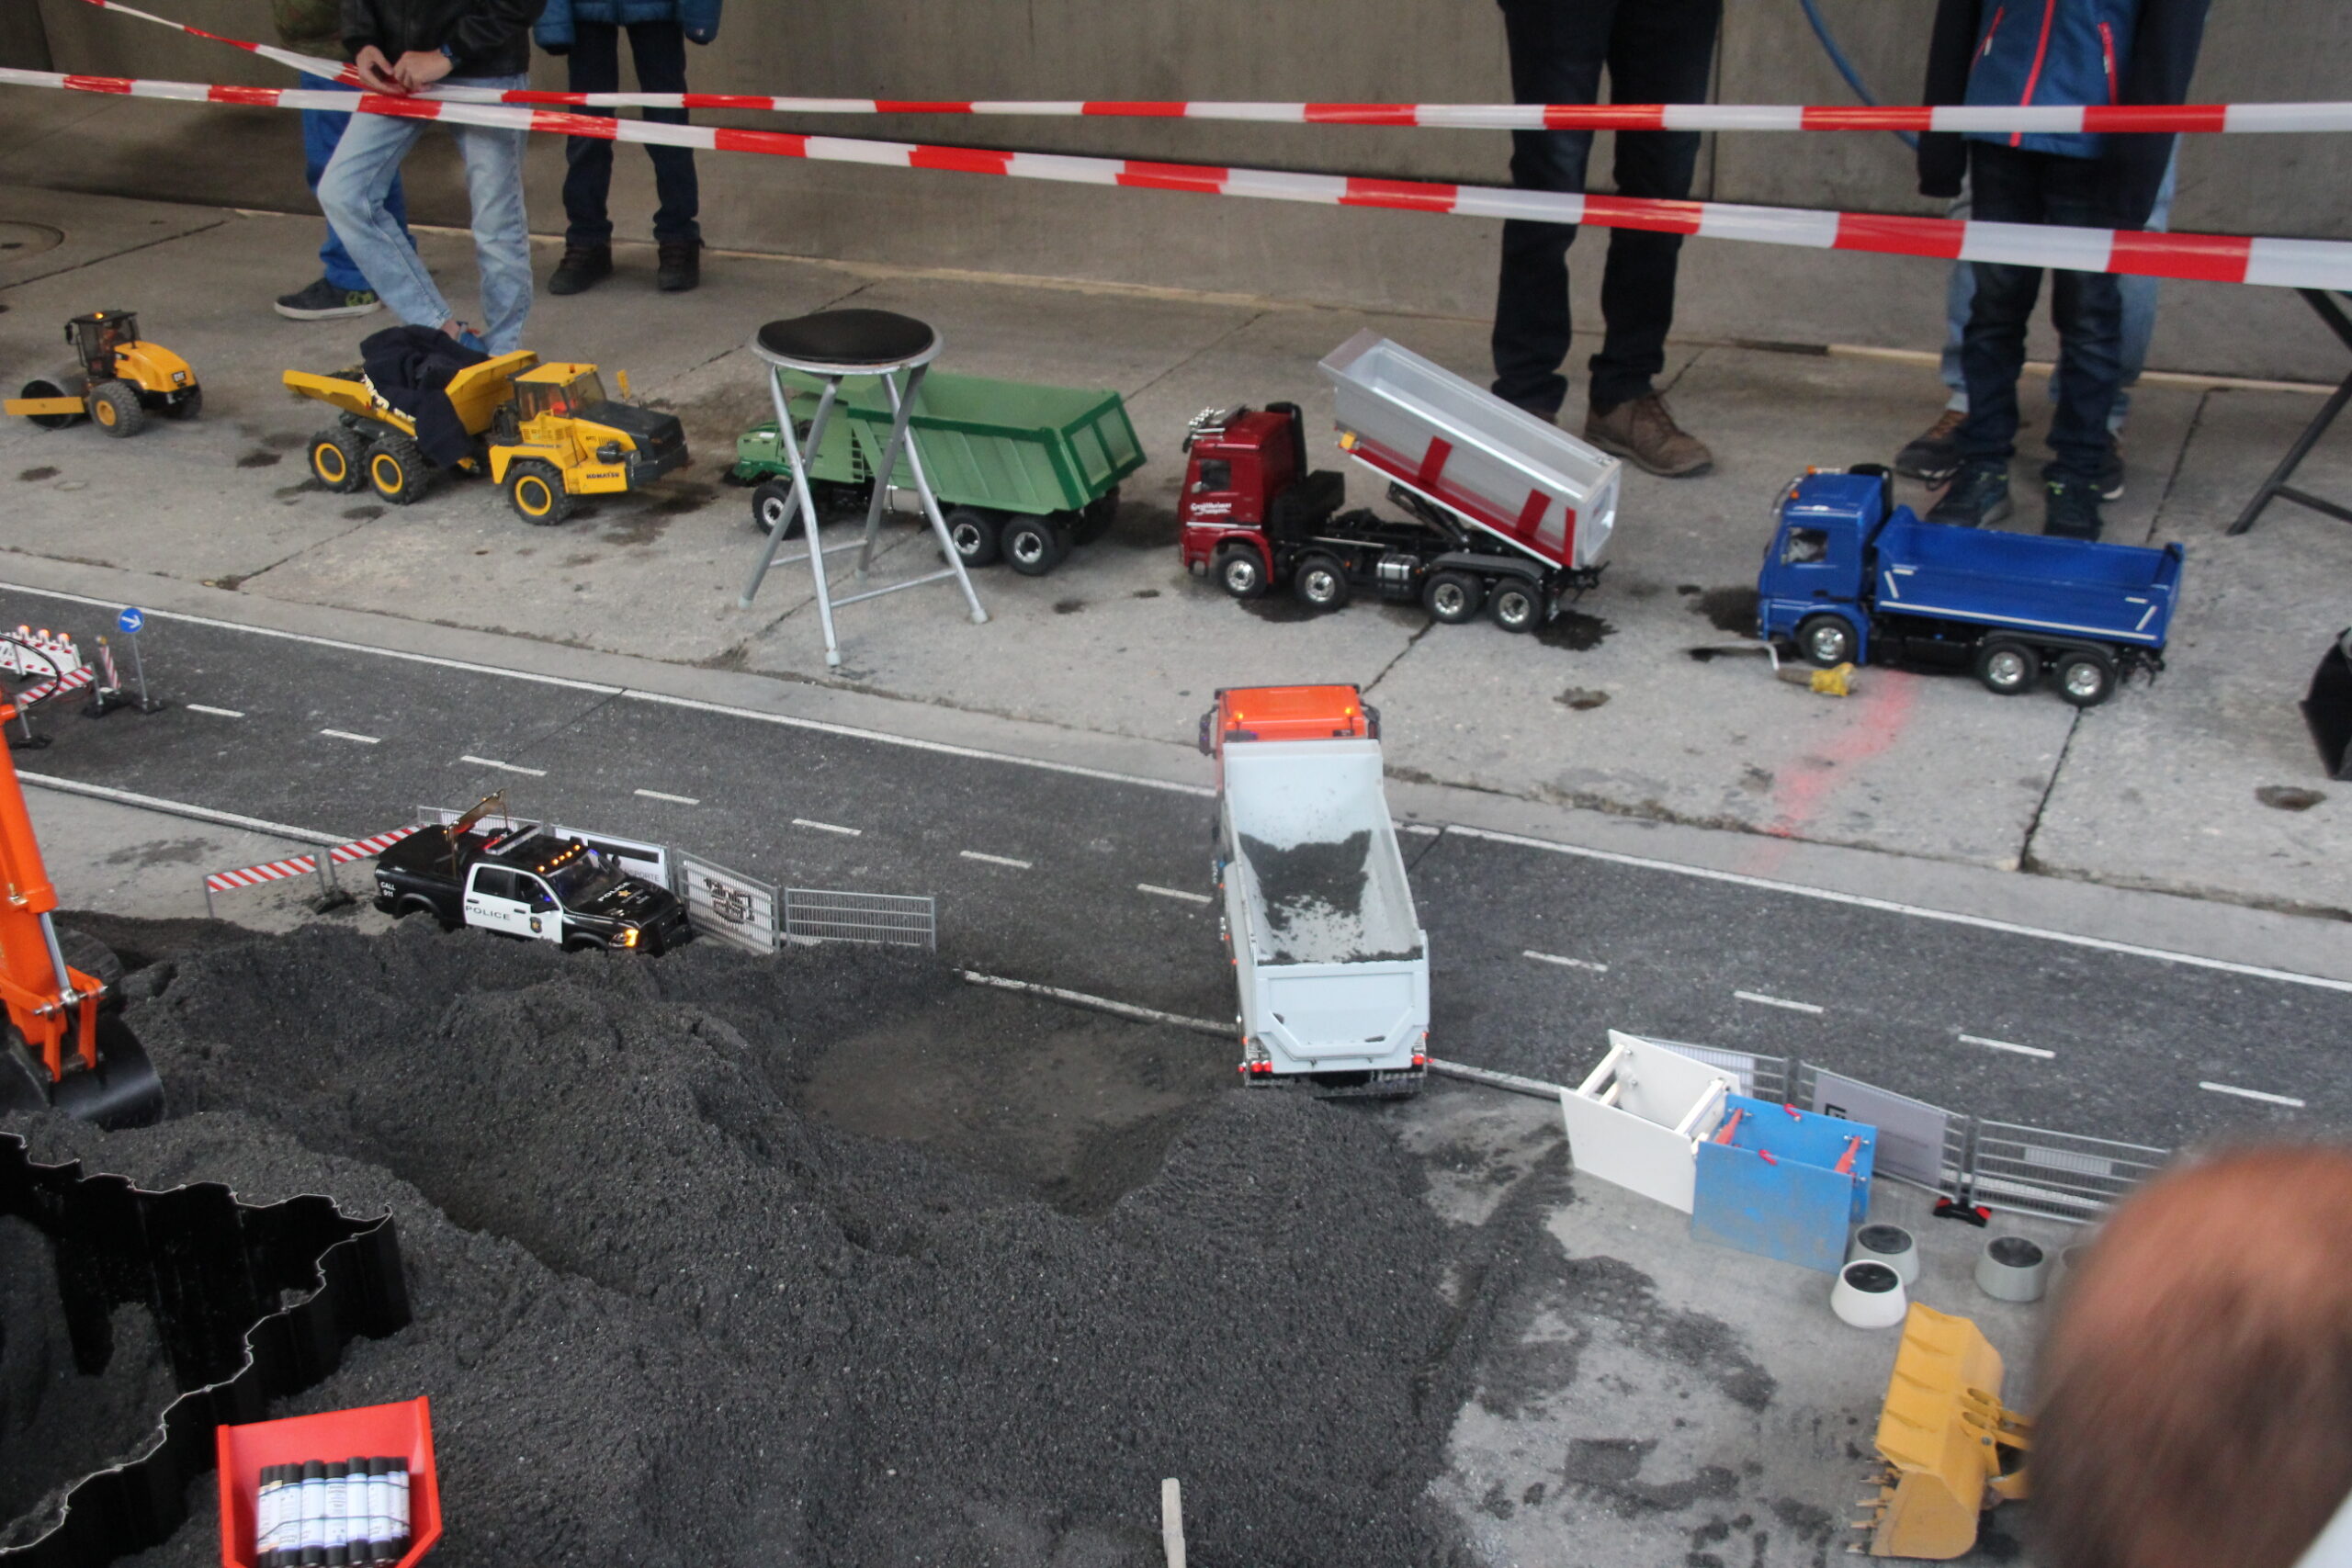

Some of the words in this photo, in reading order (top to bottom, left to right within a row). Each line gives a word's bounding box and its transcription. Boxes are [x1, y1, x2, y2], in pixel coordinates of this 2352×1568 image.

[380, 881, 396, 891] CALL
[597, 882, 632, 902] POLICE
[383, 889, 394, 897] 911
[465, 905, 512, 921] POLICE
